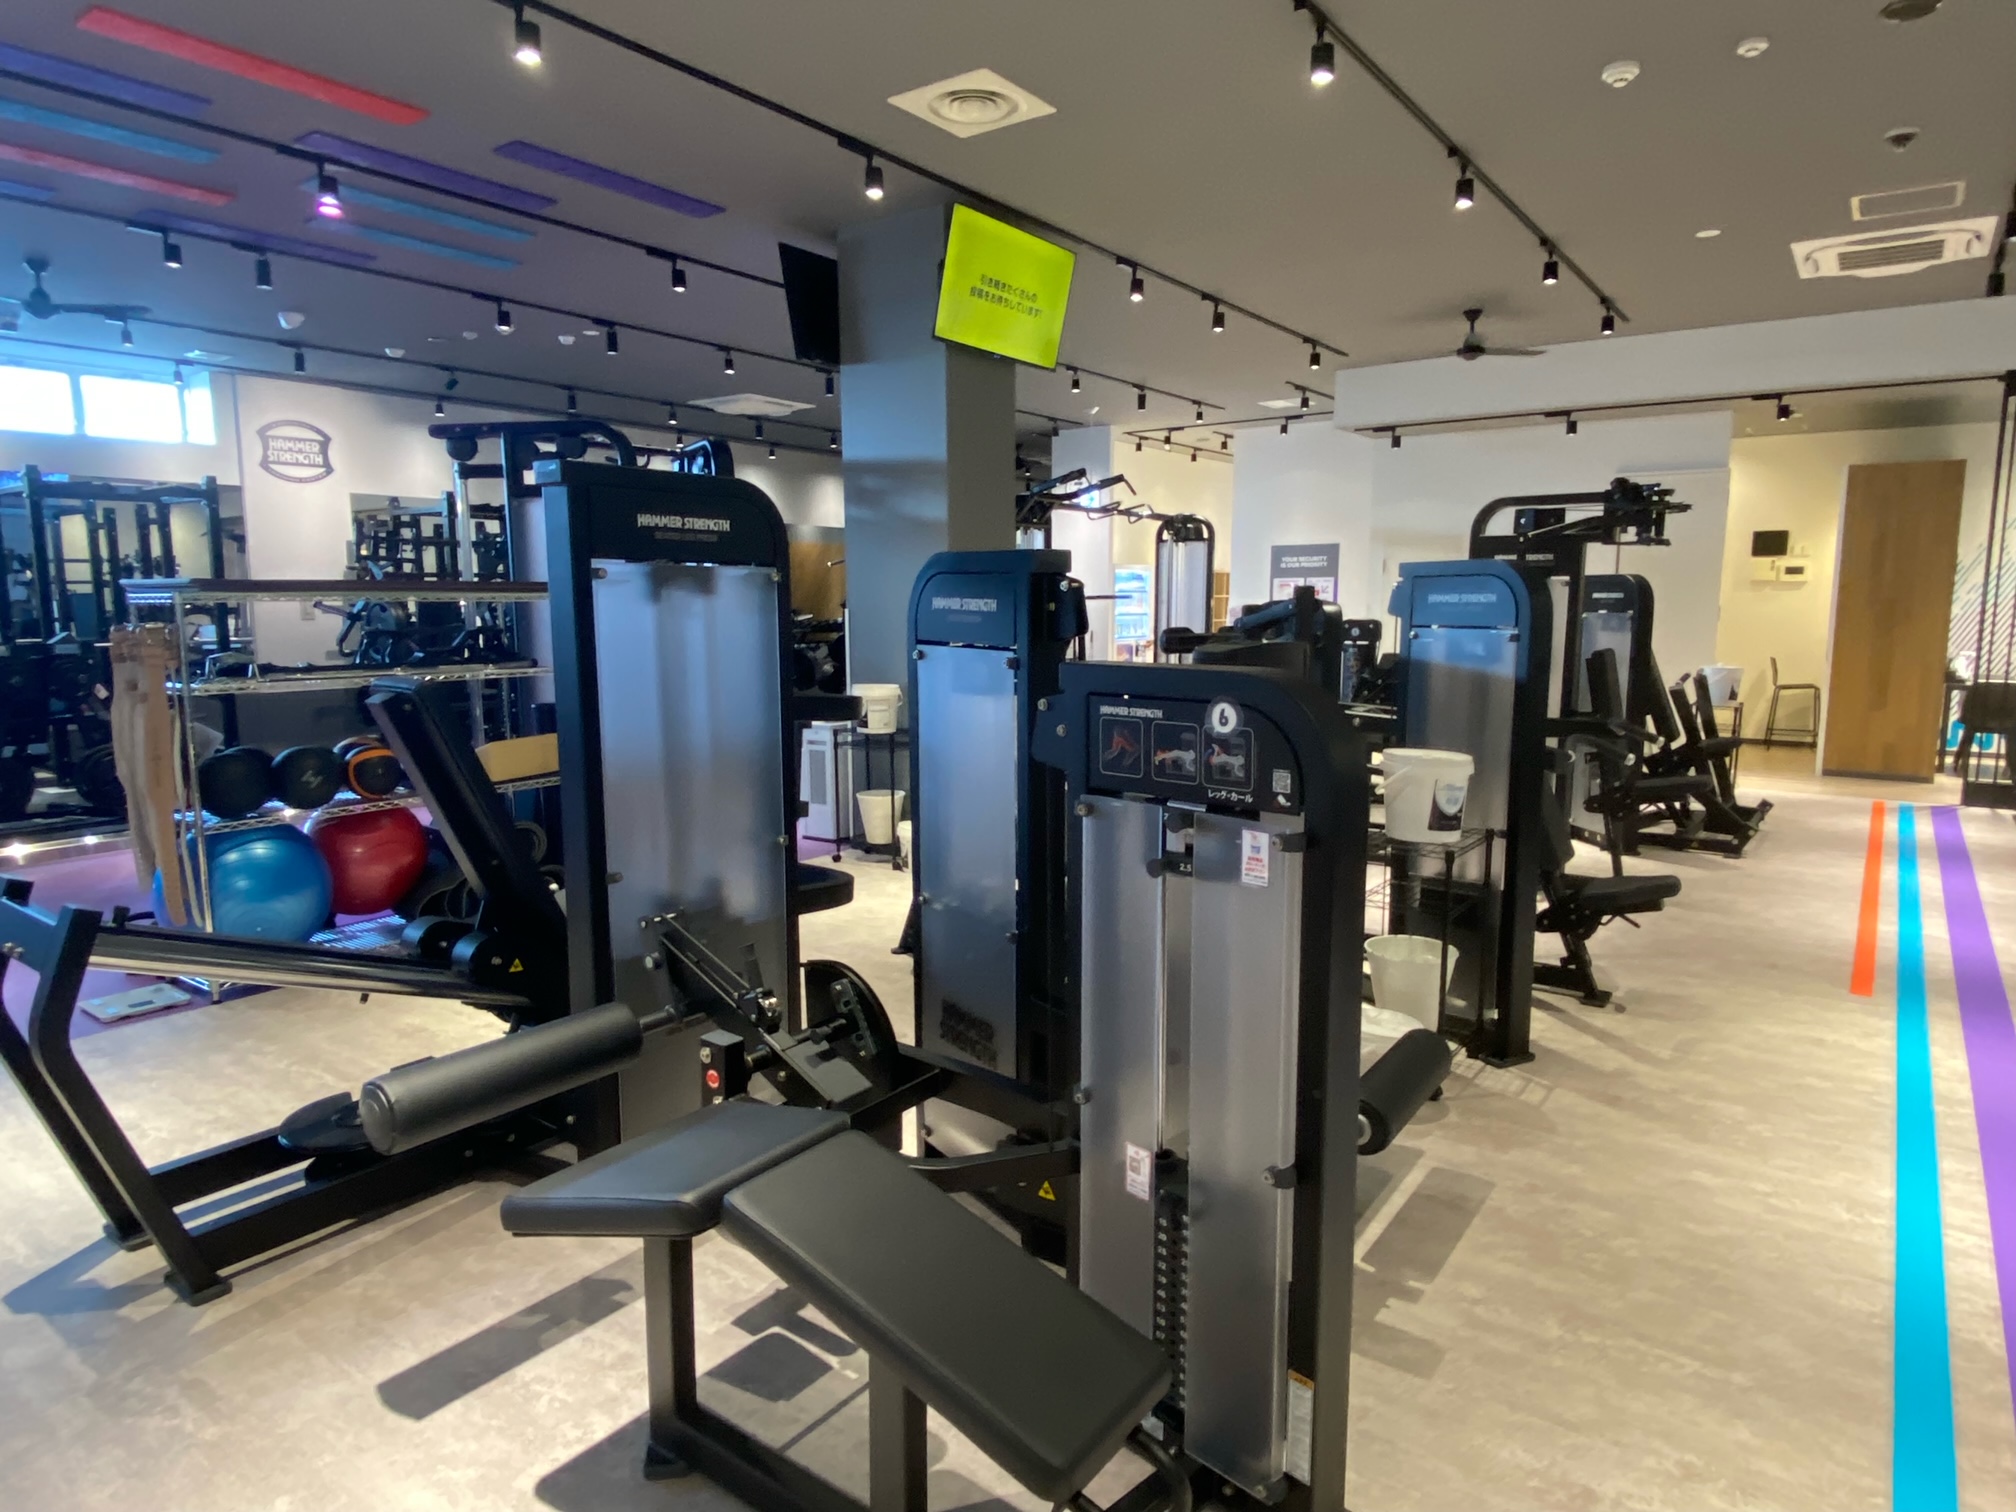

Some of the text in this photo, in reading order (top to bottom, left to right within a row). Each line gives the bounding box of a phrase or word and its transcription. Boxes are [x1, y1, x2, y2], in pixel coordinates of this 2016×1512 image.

[268, 438, 320, 453] HAMMER
[267, 450, 324, 465] STRENGTH
[637, 513, 731, 532] HAMMER STRENGTH
[1100, 704, 1163, 719] HAMMER STRENGTH
[1219, 708, 1229, 727] 6
[1207, 788, 1254, 803] レッグ・カール
[1179, 863, 1192, 872] 2.5
